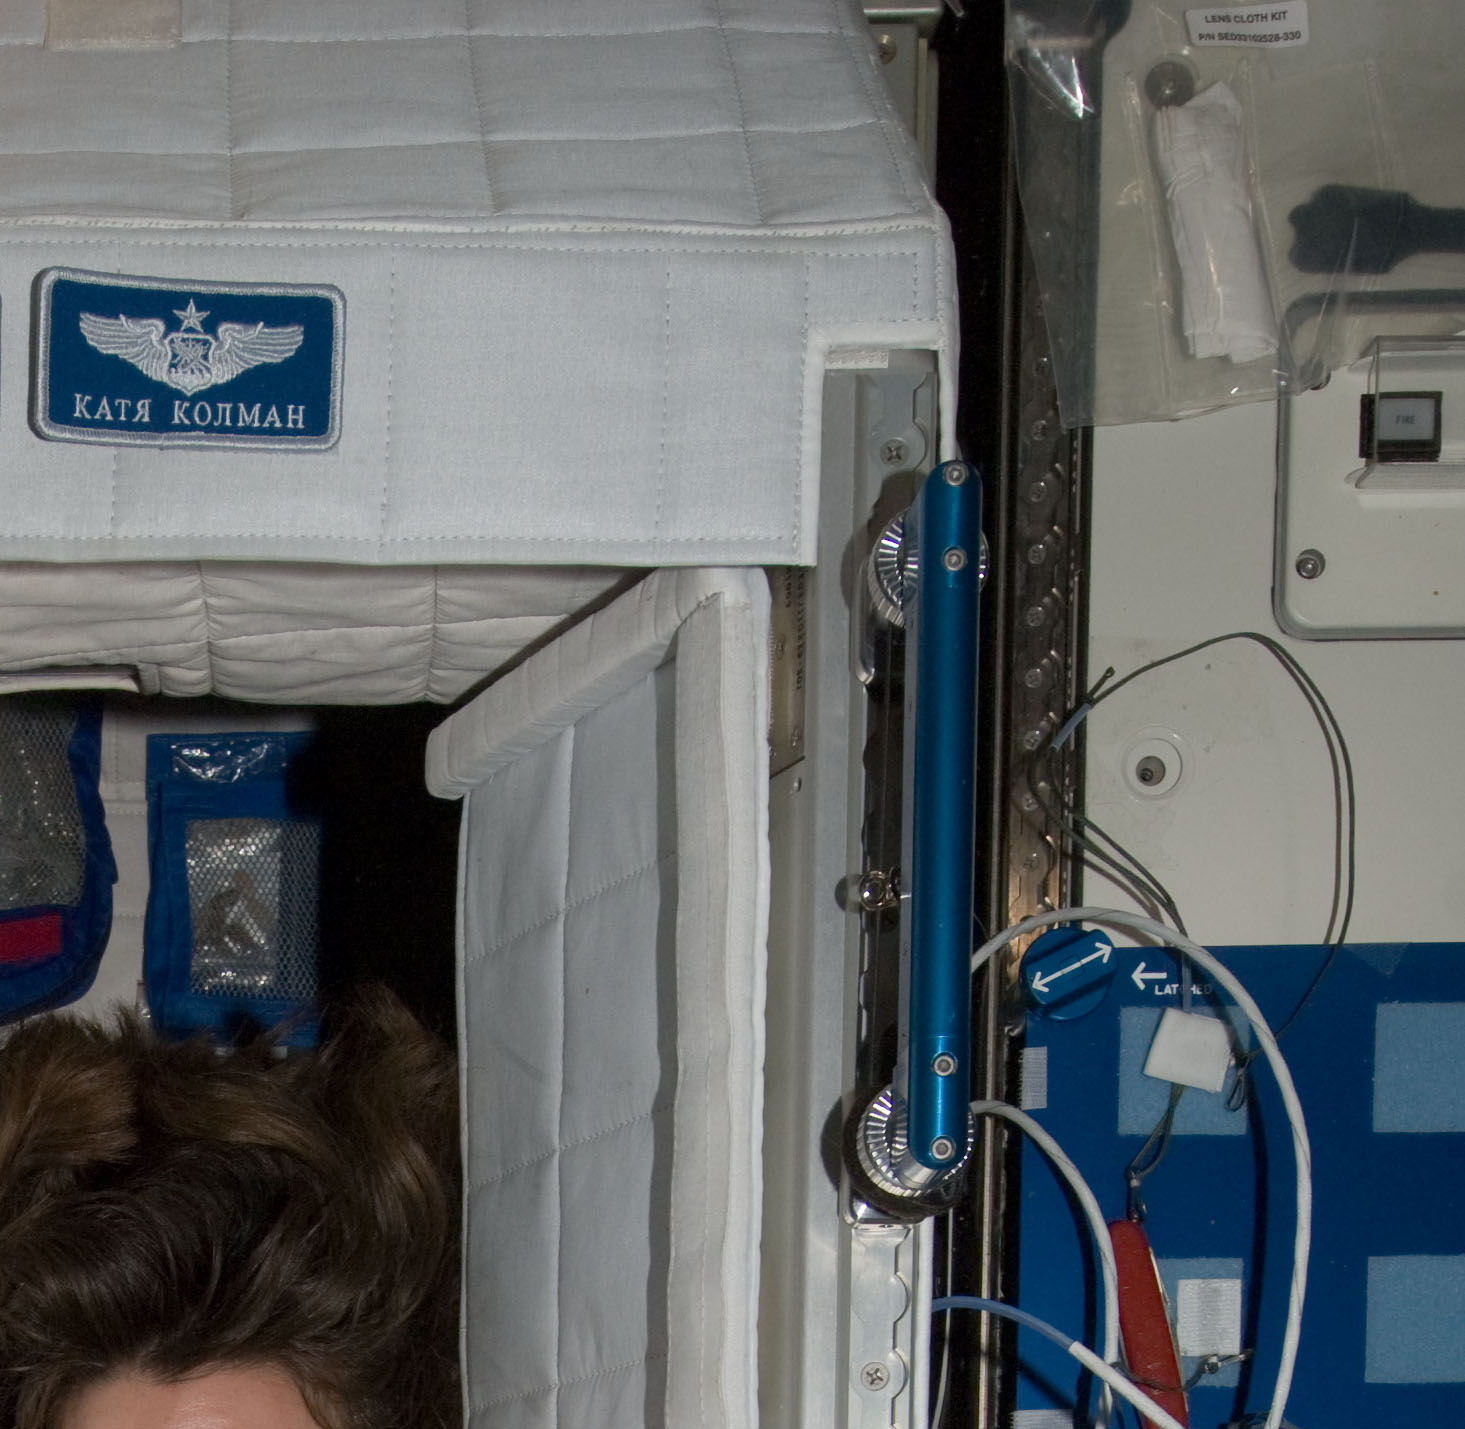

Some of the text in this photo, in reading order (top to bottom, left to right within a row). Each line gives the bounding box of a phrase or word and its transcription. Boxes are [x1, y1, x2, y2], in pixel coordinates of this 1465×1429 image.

[1204, 10, 1288, 24] LENS CLOTH KIT
[72, 393, 308, 431] КАТЯ КОЛМАН
[1395, 415, 1417, 425] FIRE
[1155, 984, 1213, 996] LATHED
